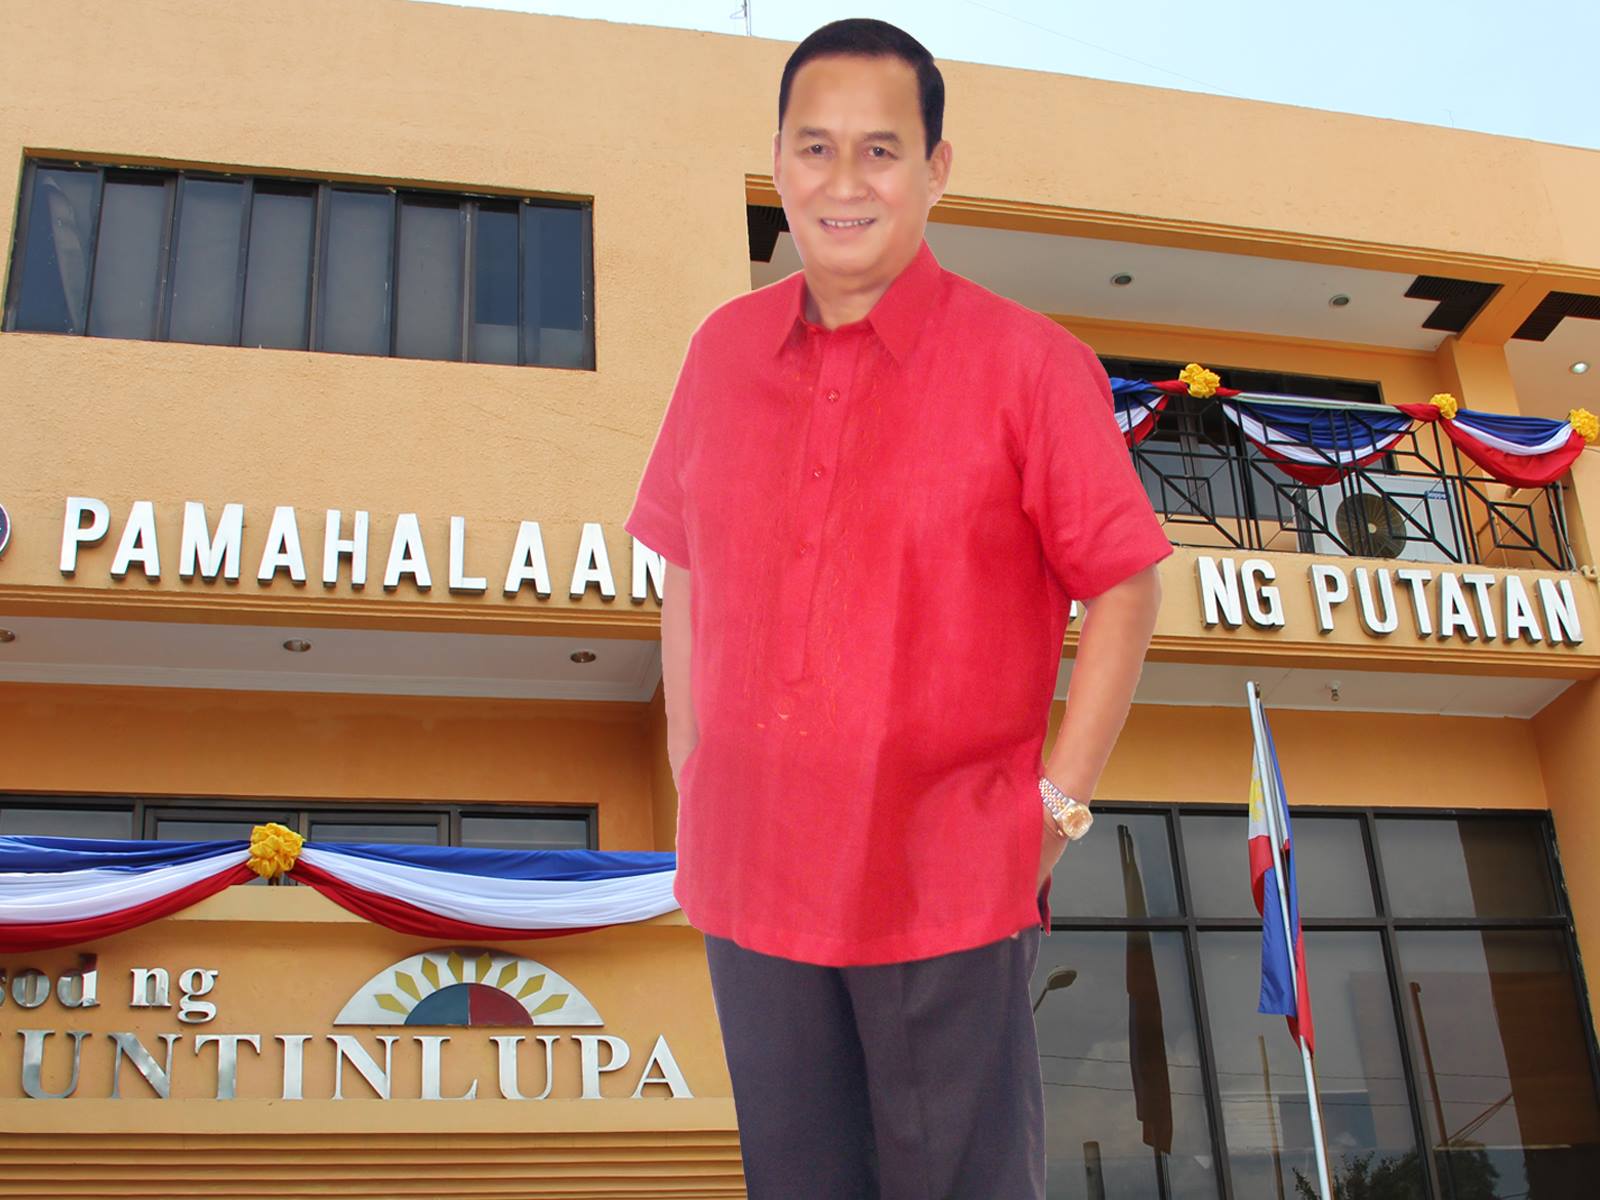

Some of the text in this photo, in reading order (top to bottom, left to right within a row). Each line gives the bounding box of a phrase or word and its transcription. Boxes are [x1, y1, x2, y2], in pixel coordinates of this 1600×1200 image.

[1197, 556, 1285, 631] NG
[1309, 564, 1584, 647] PUTATAN
[0, 953, 219, 1023] od ng
